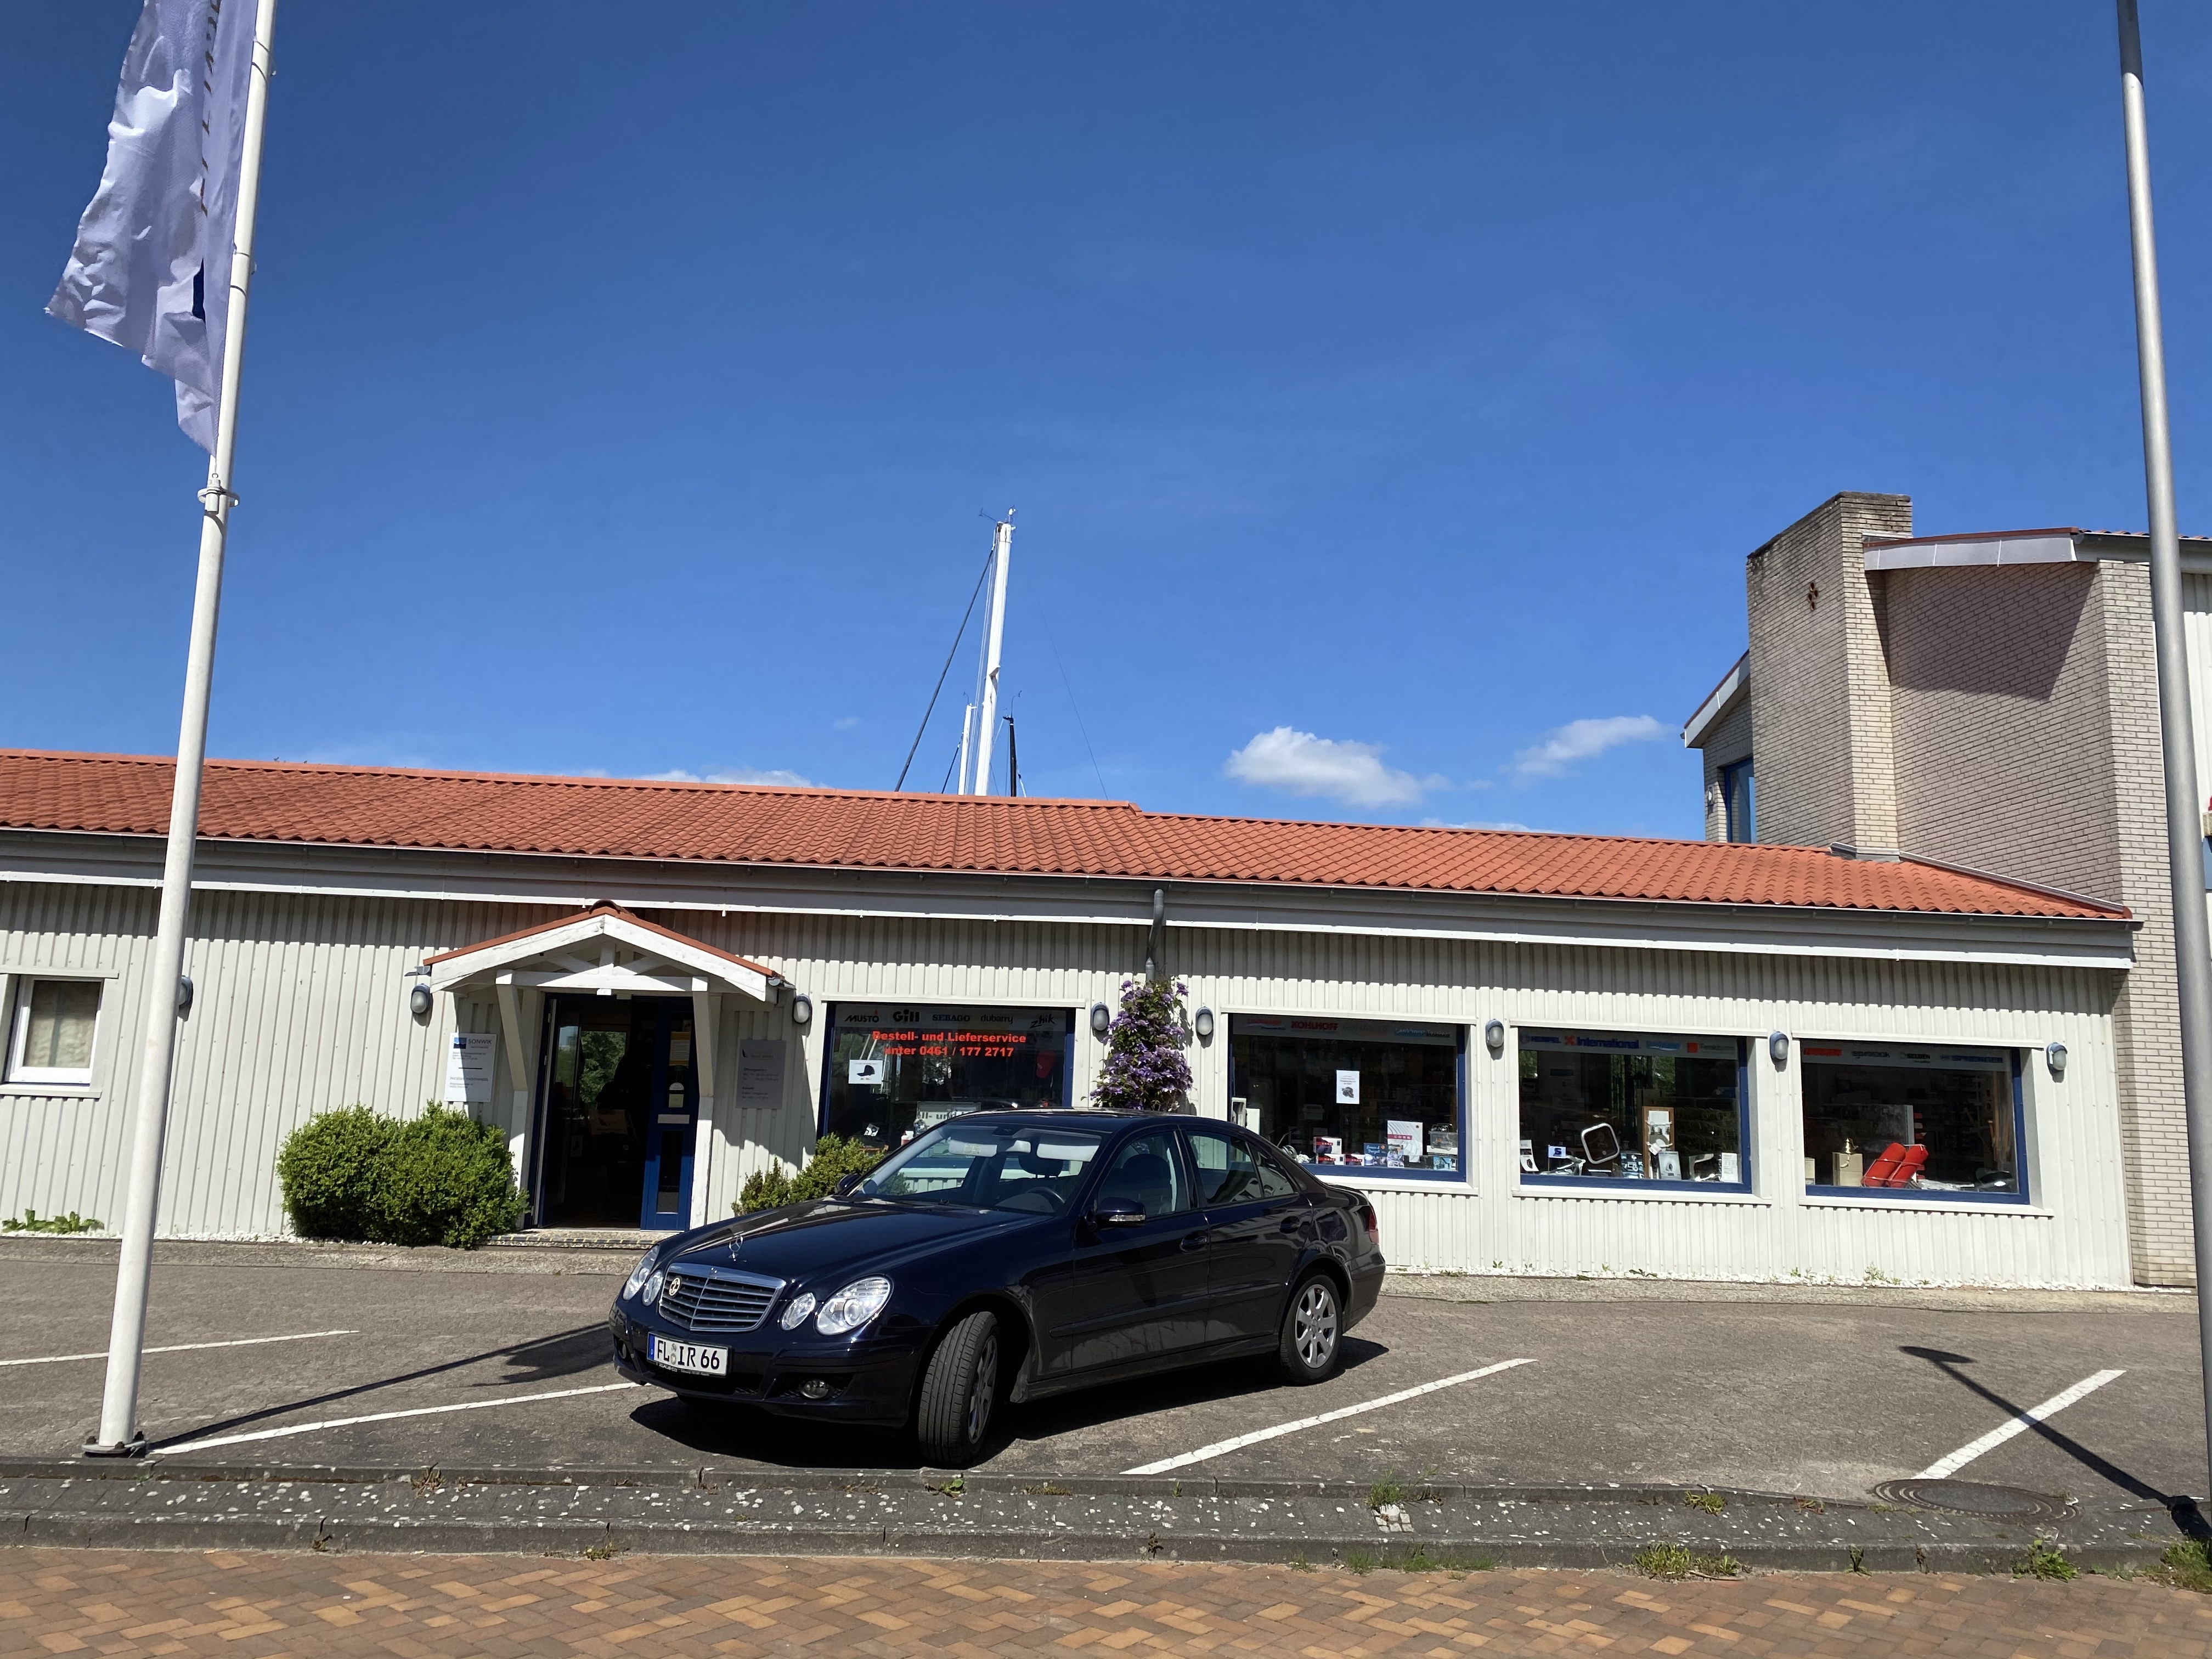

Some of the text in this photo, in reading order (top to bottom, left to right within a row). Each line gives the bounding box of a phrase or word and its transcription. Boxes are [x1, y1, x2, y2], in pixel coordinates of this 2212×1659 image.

[844, 1014, 879, 1023] MUSTO
[893, 1009, 920, 1022] Gill
[932, 1014, 970, 1023] SEBAGO
[980, 1014, 1014, 1025] dubarry
[1291, 1021, 1339, 1030] KOHLHOFF
[872, 1030, 1026, 1042] Bestell- und Lieferservice
[1576, 1037, 1640, 1049] International
[884, 1046, 1014, 1056] unter 0461 / 177 2717
[657, 1340, 670, 1362] FL
[678, 1346, 696, 1367] IR
[701, 1349, 720, 1370] 66
